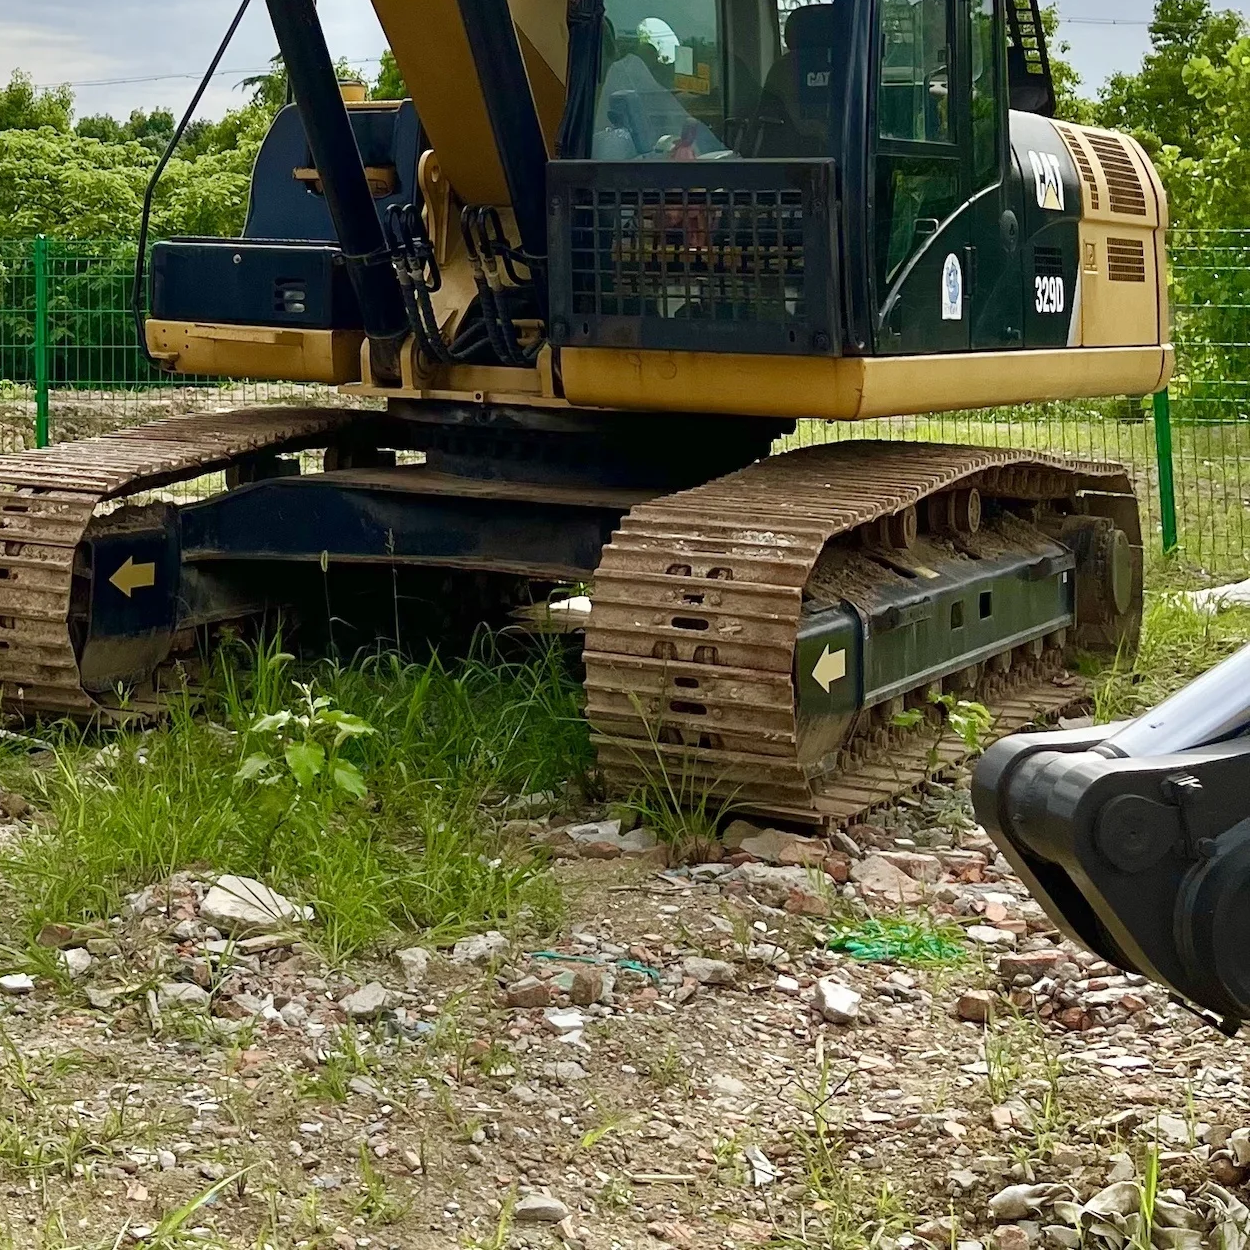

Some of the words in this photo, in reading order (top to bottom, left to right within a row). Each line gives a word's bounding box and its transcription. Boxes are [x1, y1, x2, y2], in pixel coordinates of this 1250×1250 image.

[807, 71, 831, 87] CAT
[1028, 150, 1065, 211] CAT
[1034, 275, 1065, 314] 329D
